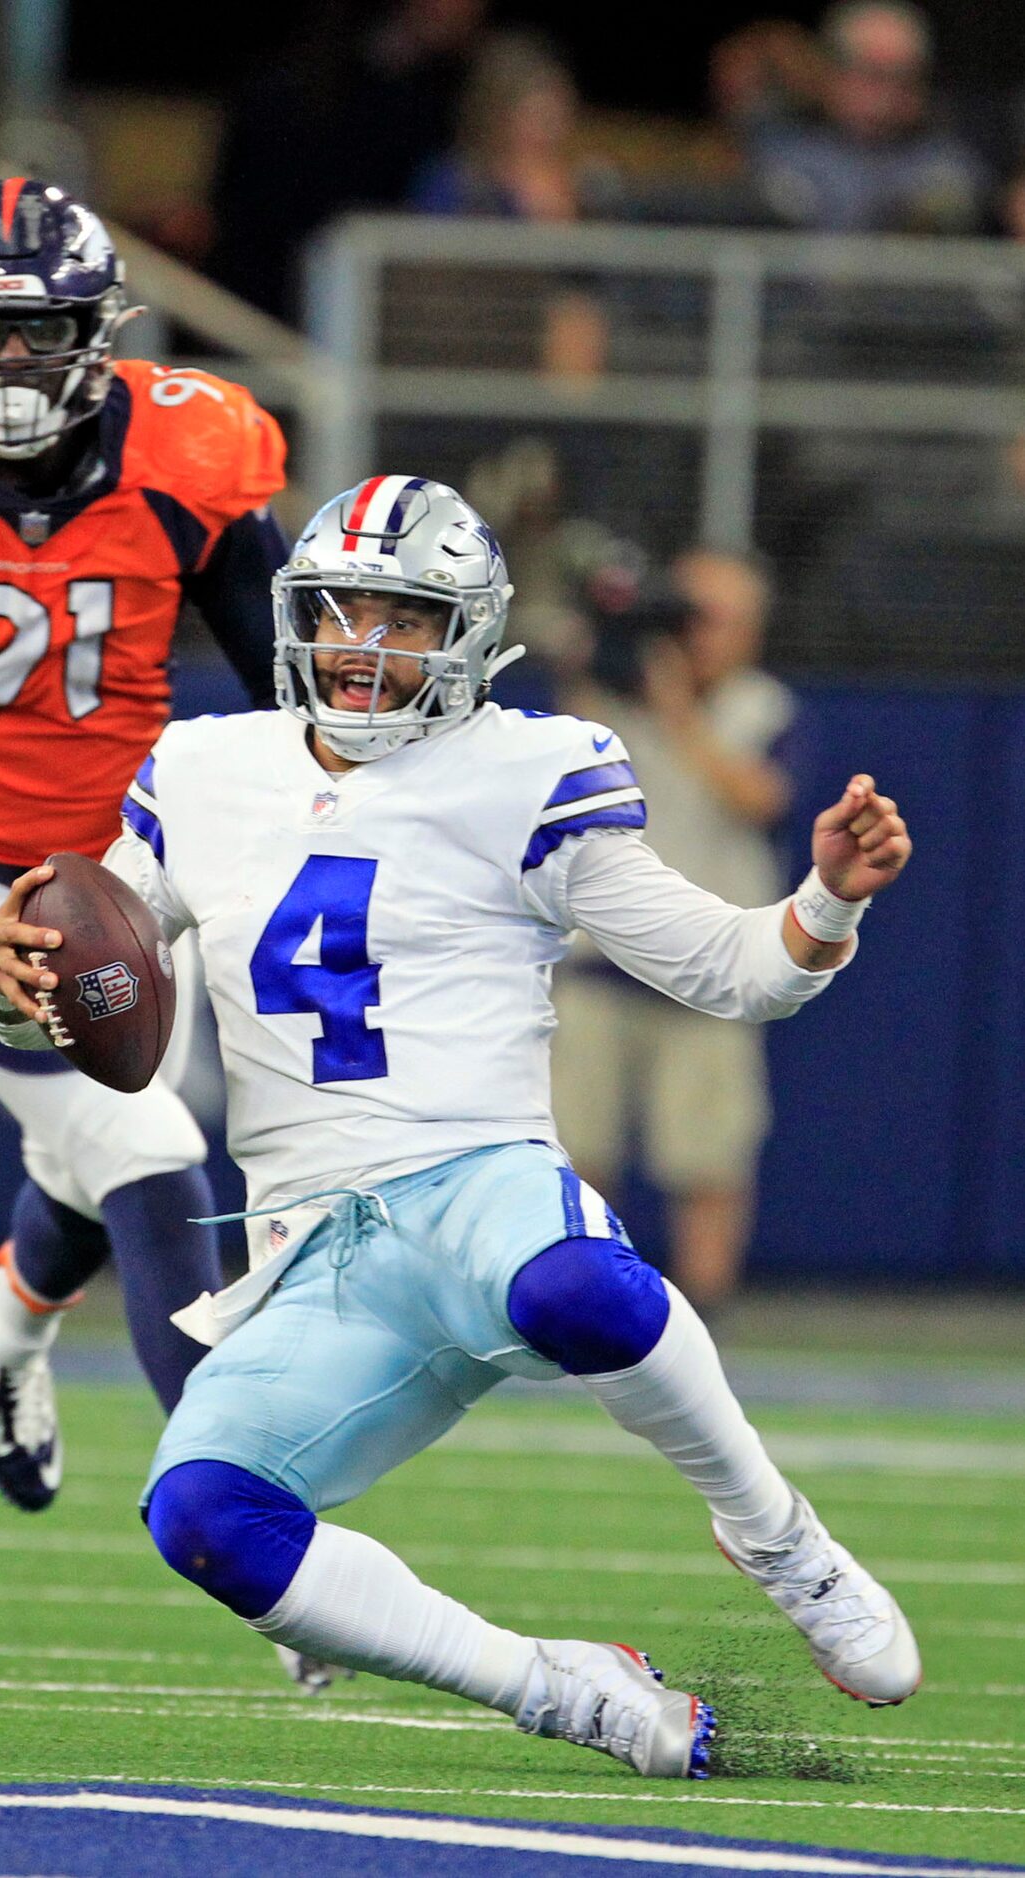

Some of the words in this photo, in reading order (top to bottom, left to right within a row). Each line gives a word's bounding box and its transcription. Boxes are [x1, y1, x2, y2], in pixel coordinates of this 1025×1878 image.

[149, 366, 225, 407] 9
[101, 968, 132, 1009] NFL
[249, 853, 389, 1085] 4
